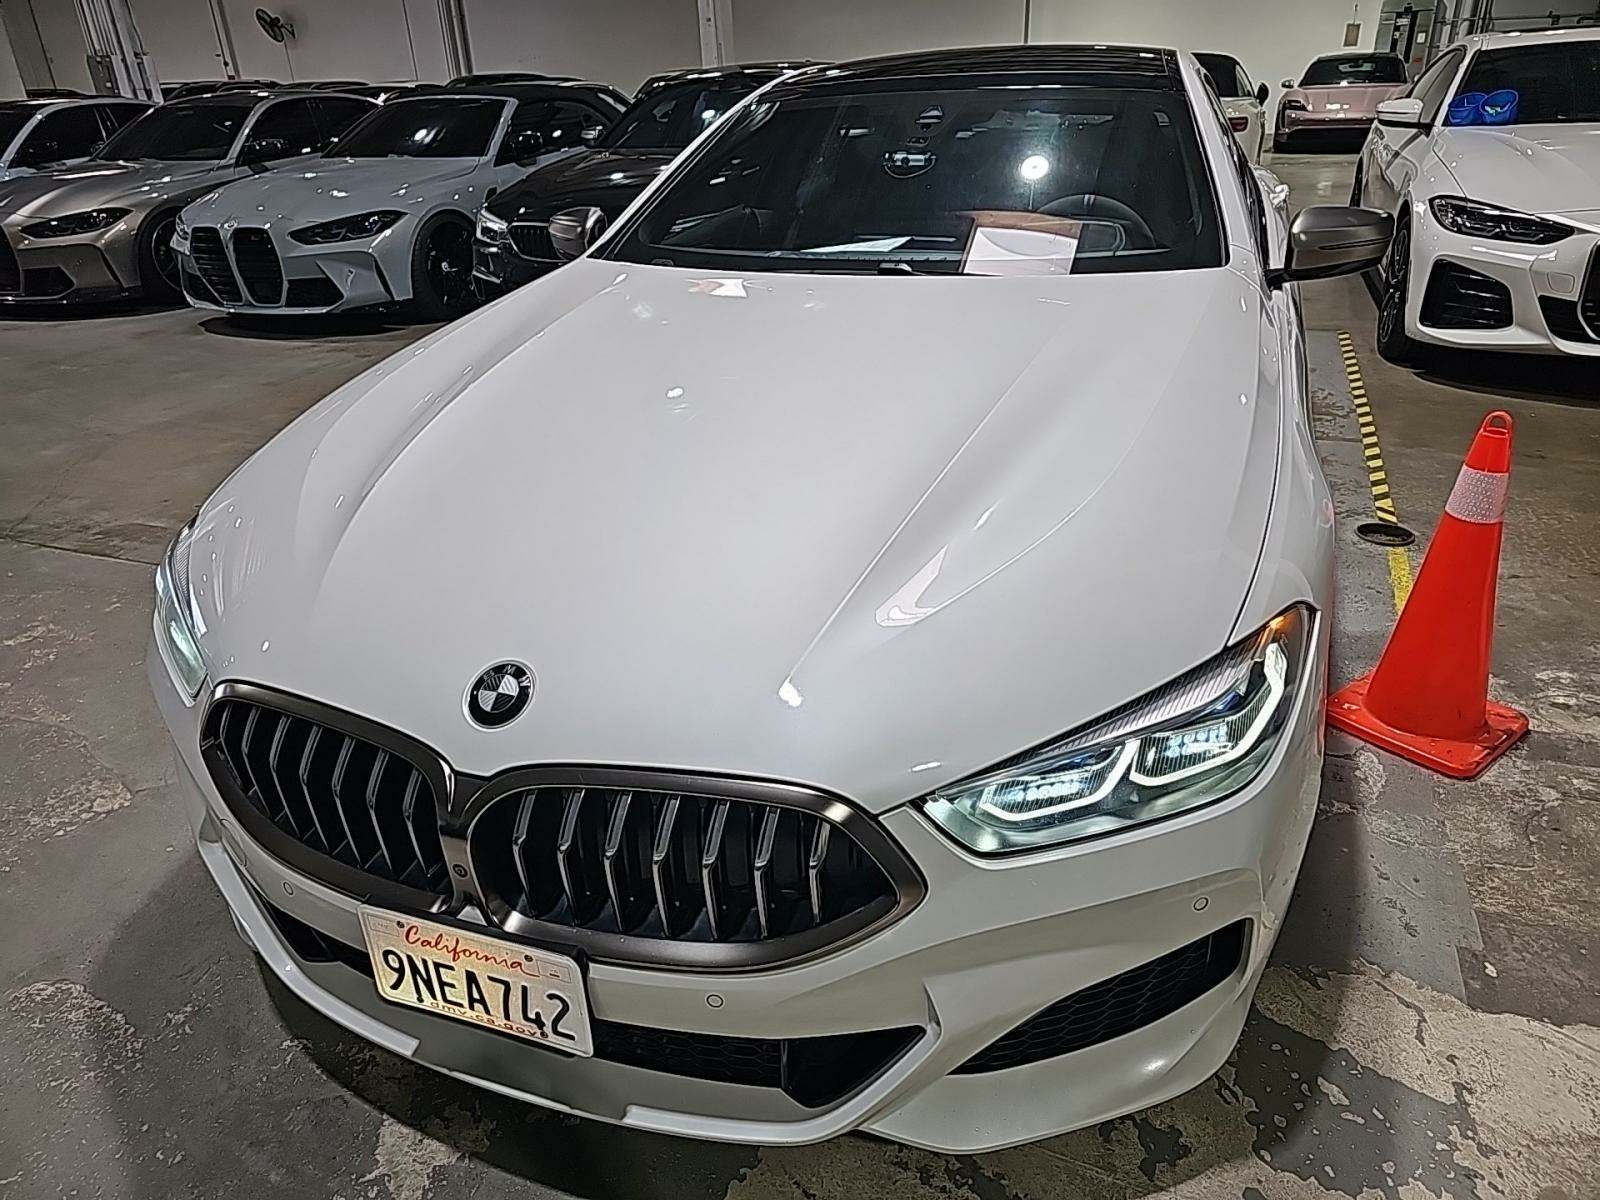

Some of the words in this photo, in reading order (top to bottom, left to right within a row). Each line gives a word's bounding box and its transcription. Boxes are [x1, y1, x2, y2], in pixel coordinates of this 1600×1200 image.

[483, 664, 530, 686] BMW
[404, 925, 540, 978] California
[382, 949, 576, 1041] 9NEA742
[430, 1000, 537, 1037] dmv.ca.gov
